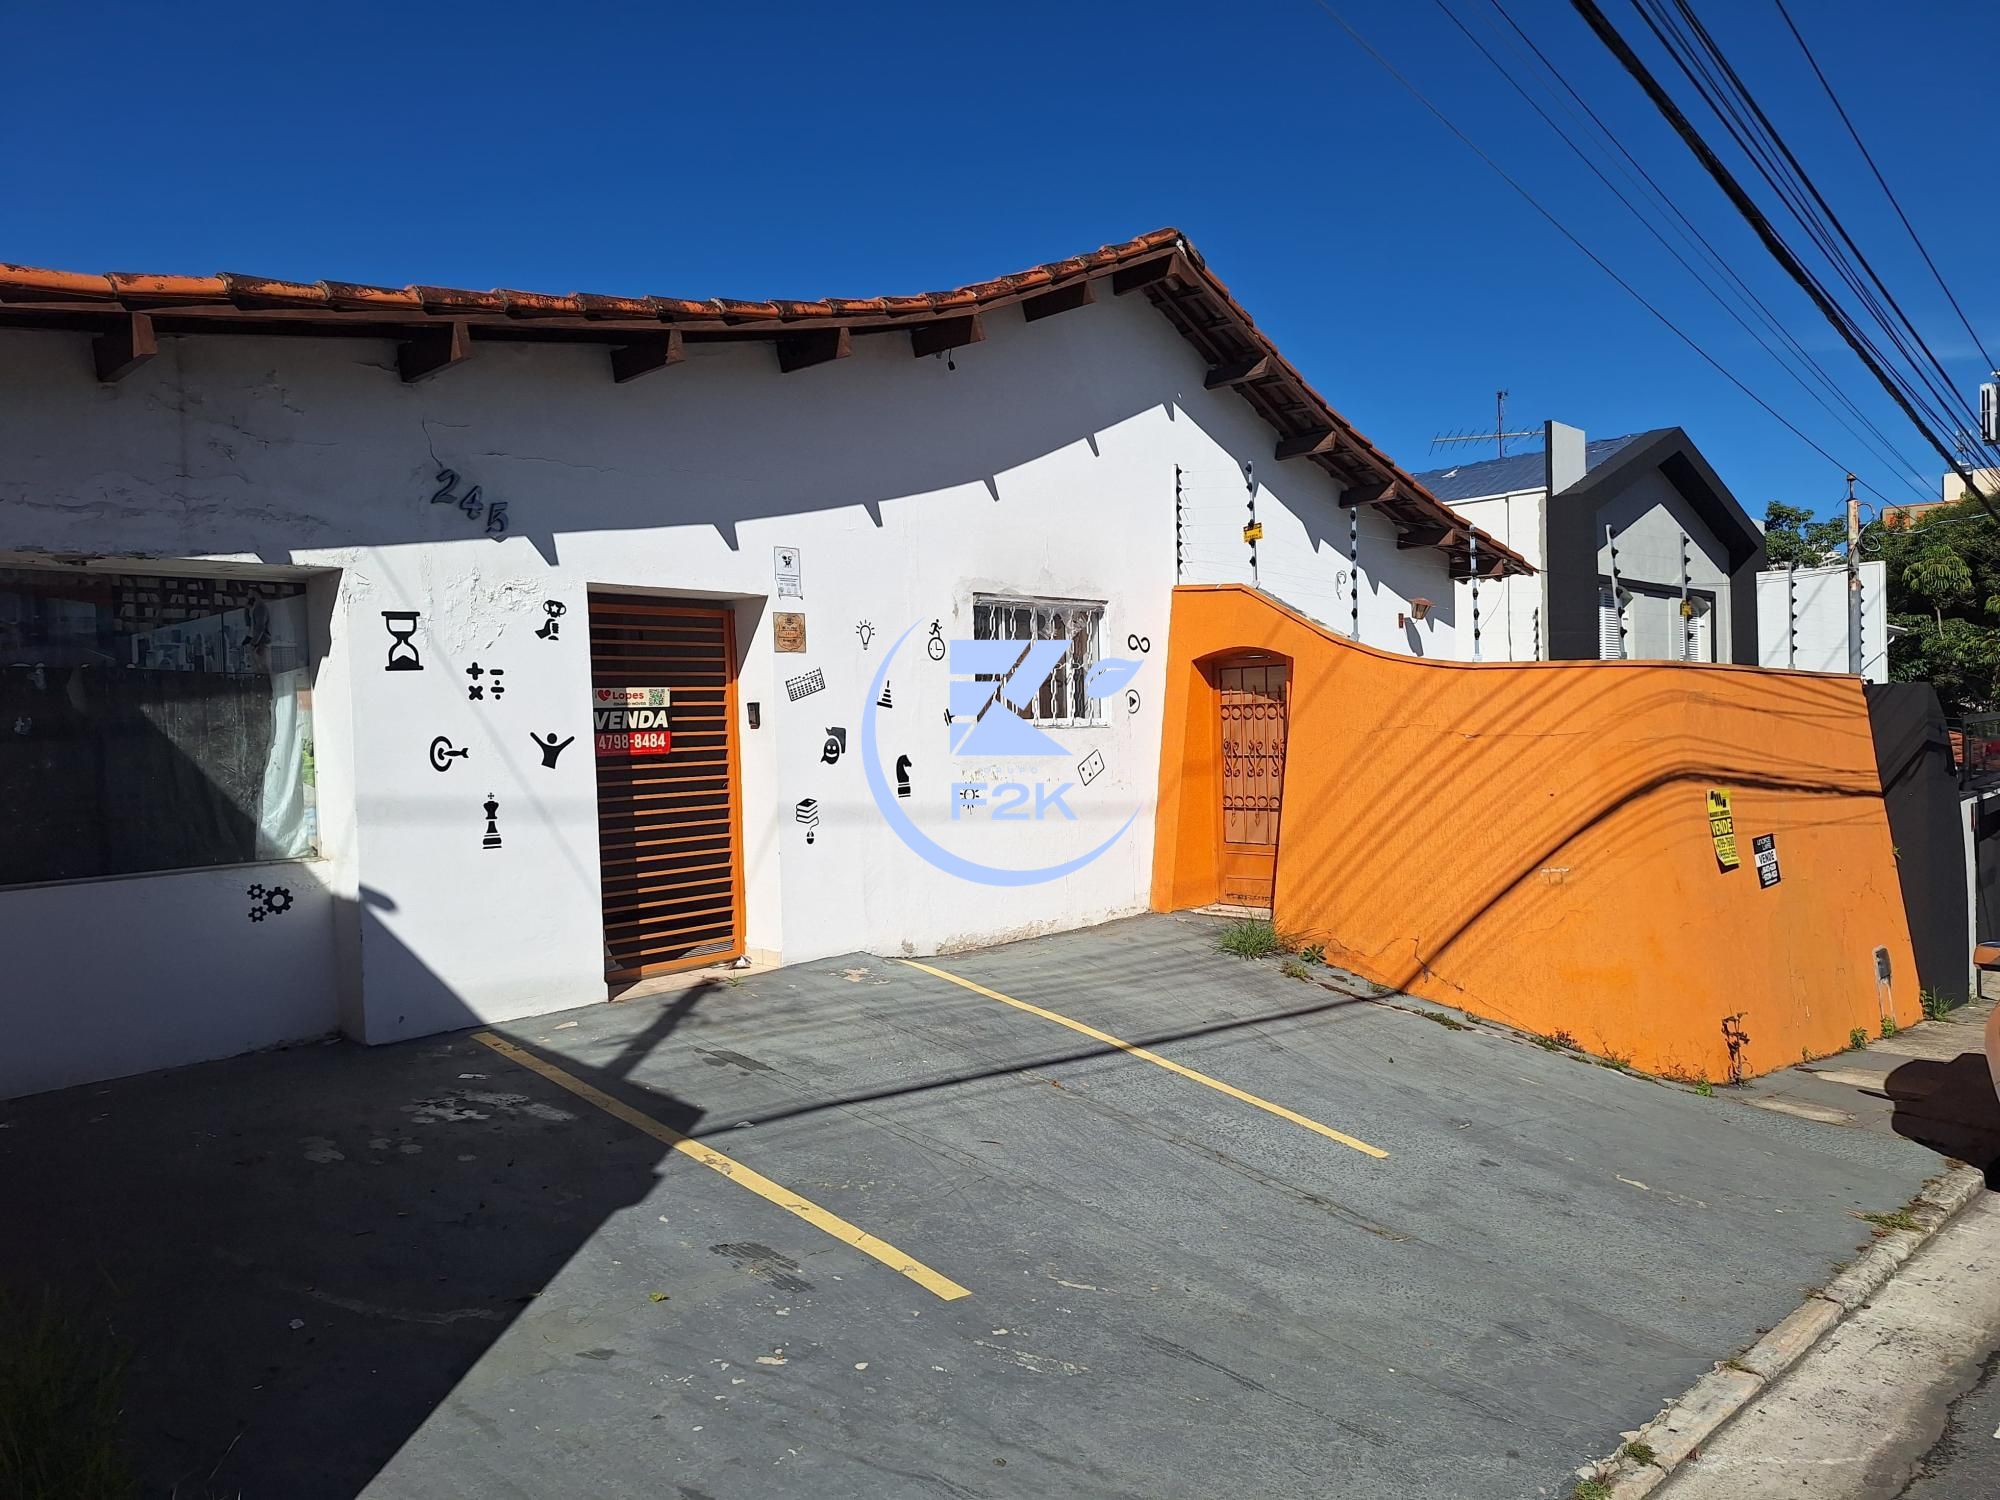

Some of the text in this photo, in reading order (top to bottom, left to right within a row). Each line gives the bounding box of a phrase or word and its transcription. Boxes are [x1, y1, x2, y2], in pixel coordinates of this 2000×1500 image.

[430, 468, 509, 534] 245
[612, 691, 645, 701] Lopes
[593, 709, 669, 730] VENDA
[598, 733, 666, 750] 4798-8484
[1711, 818, 1733, 836] VENDE
[1758, 850, 1775, 865] VENDE
